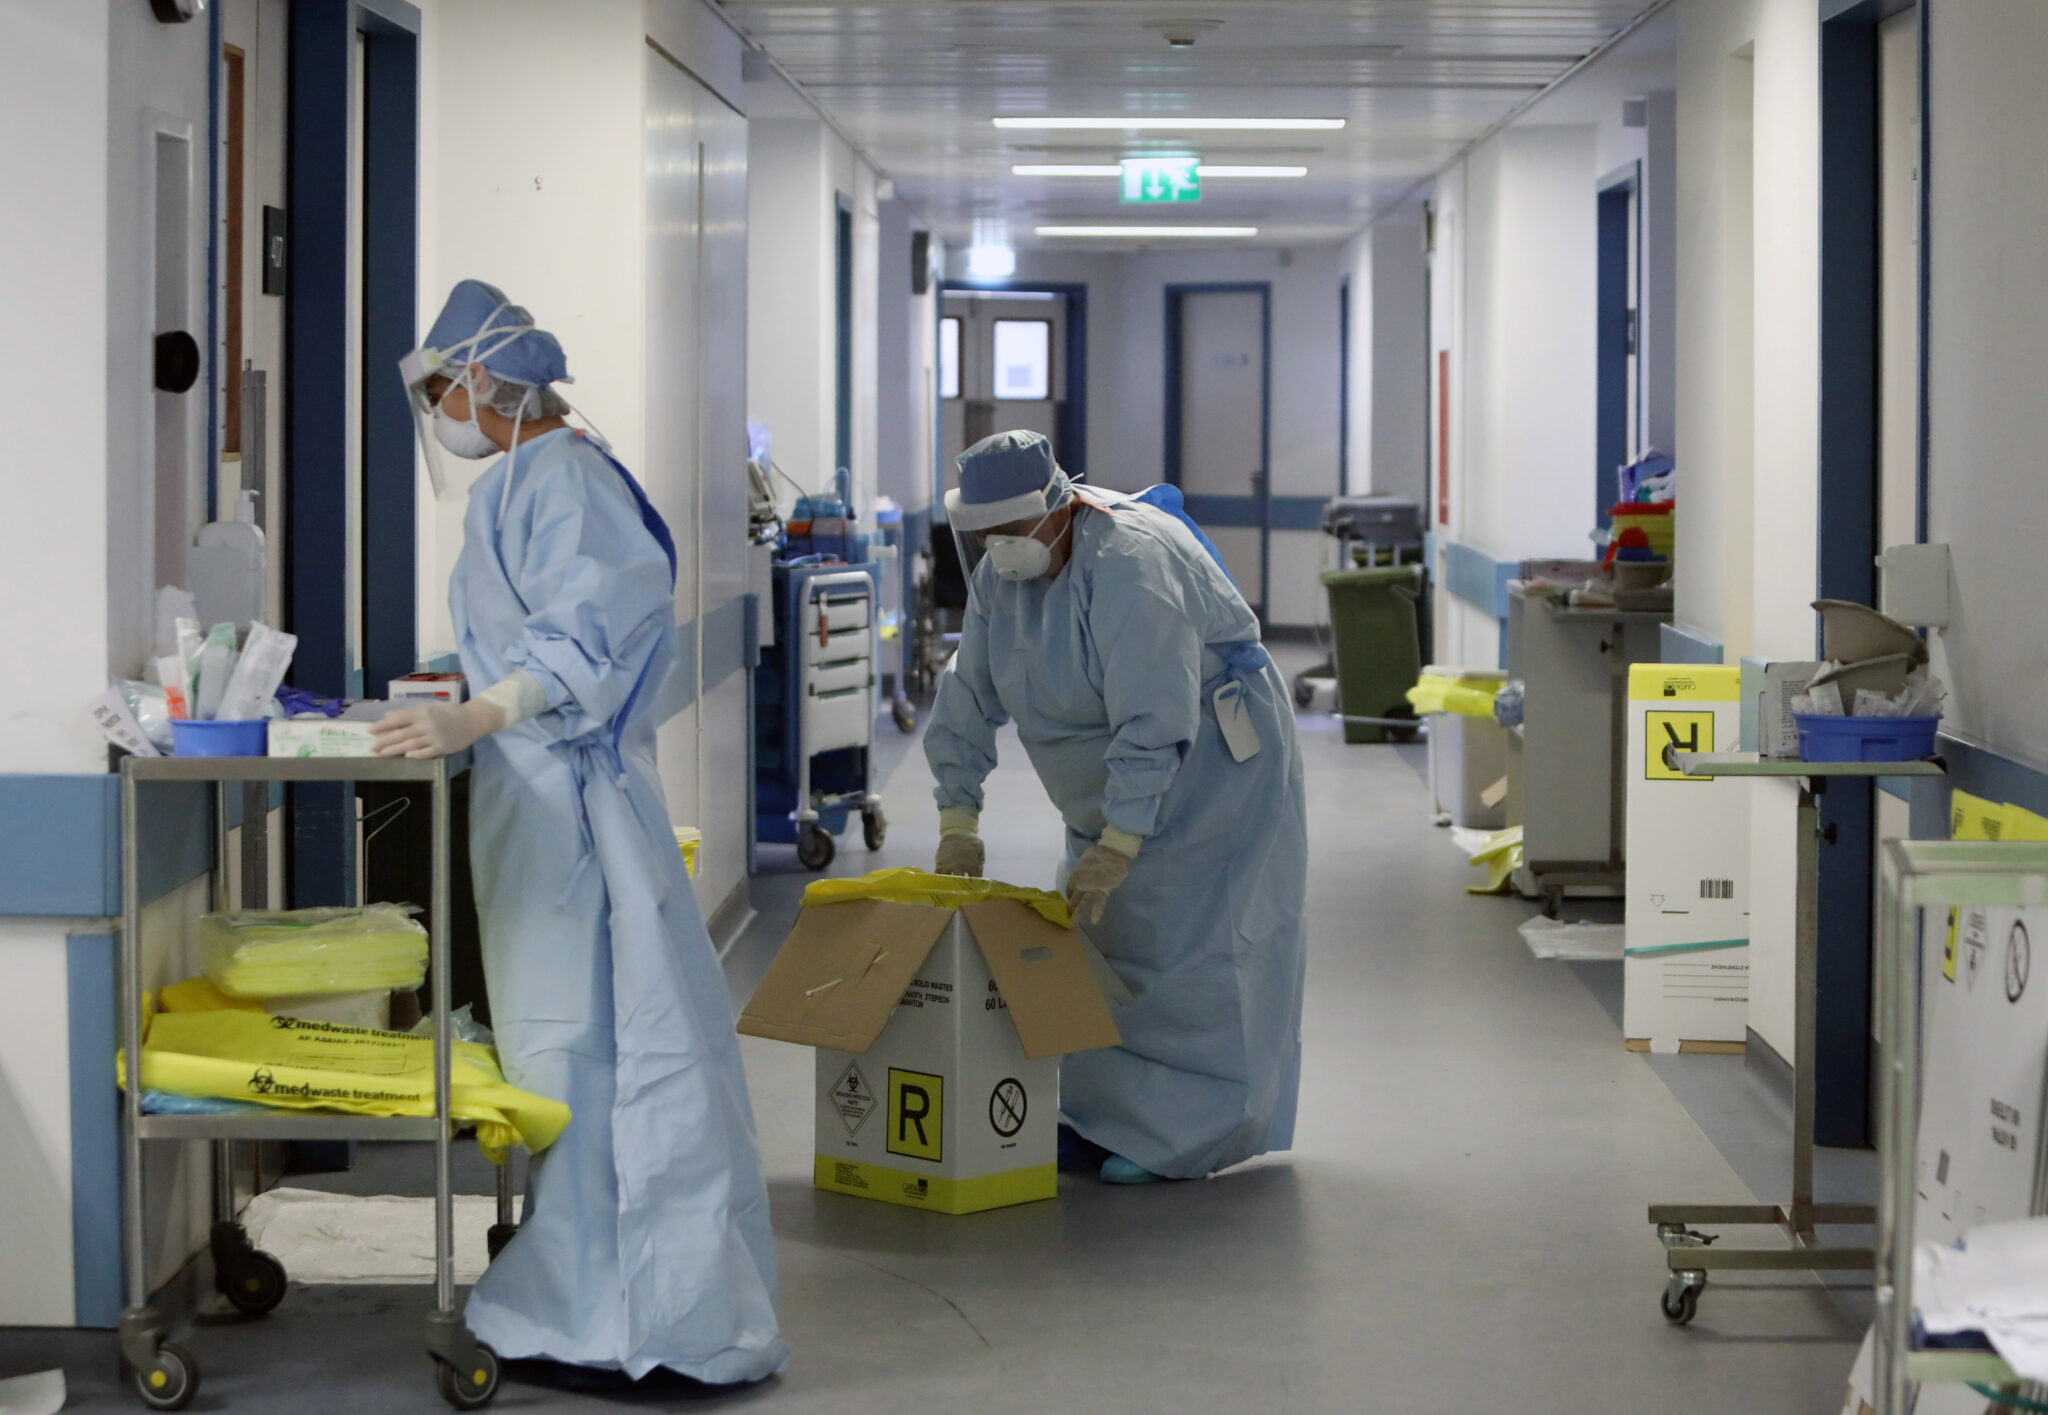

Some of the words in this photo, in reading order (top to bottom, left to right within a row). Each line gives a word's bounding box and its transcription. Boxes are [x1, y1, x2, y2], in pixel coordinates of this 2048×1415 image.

[985, 998, 996, 1011] 60
[296, 1020, 369, 1035] medwaste
[371, 1029, 432, 1041] treatmen
[275, 1082, 351, 1099] medwaste
[353, 1087, 421, 1103] treatment
[899, 1083, 930, 1146] R
